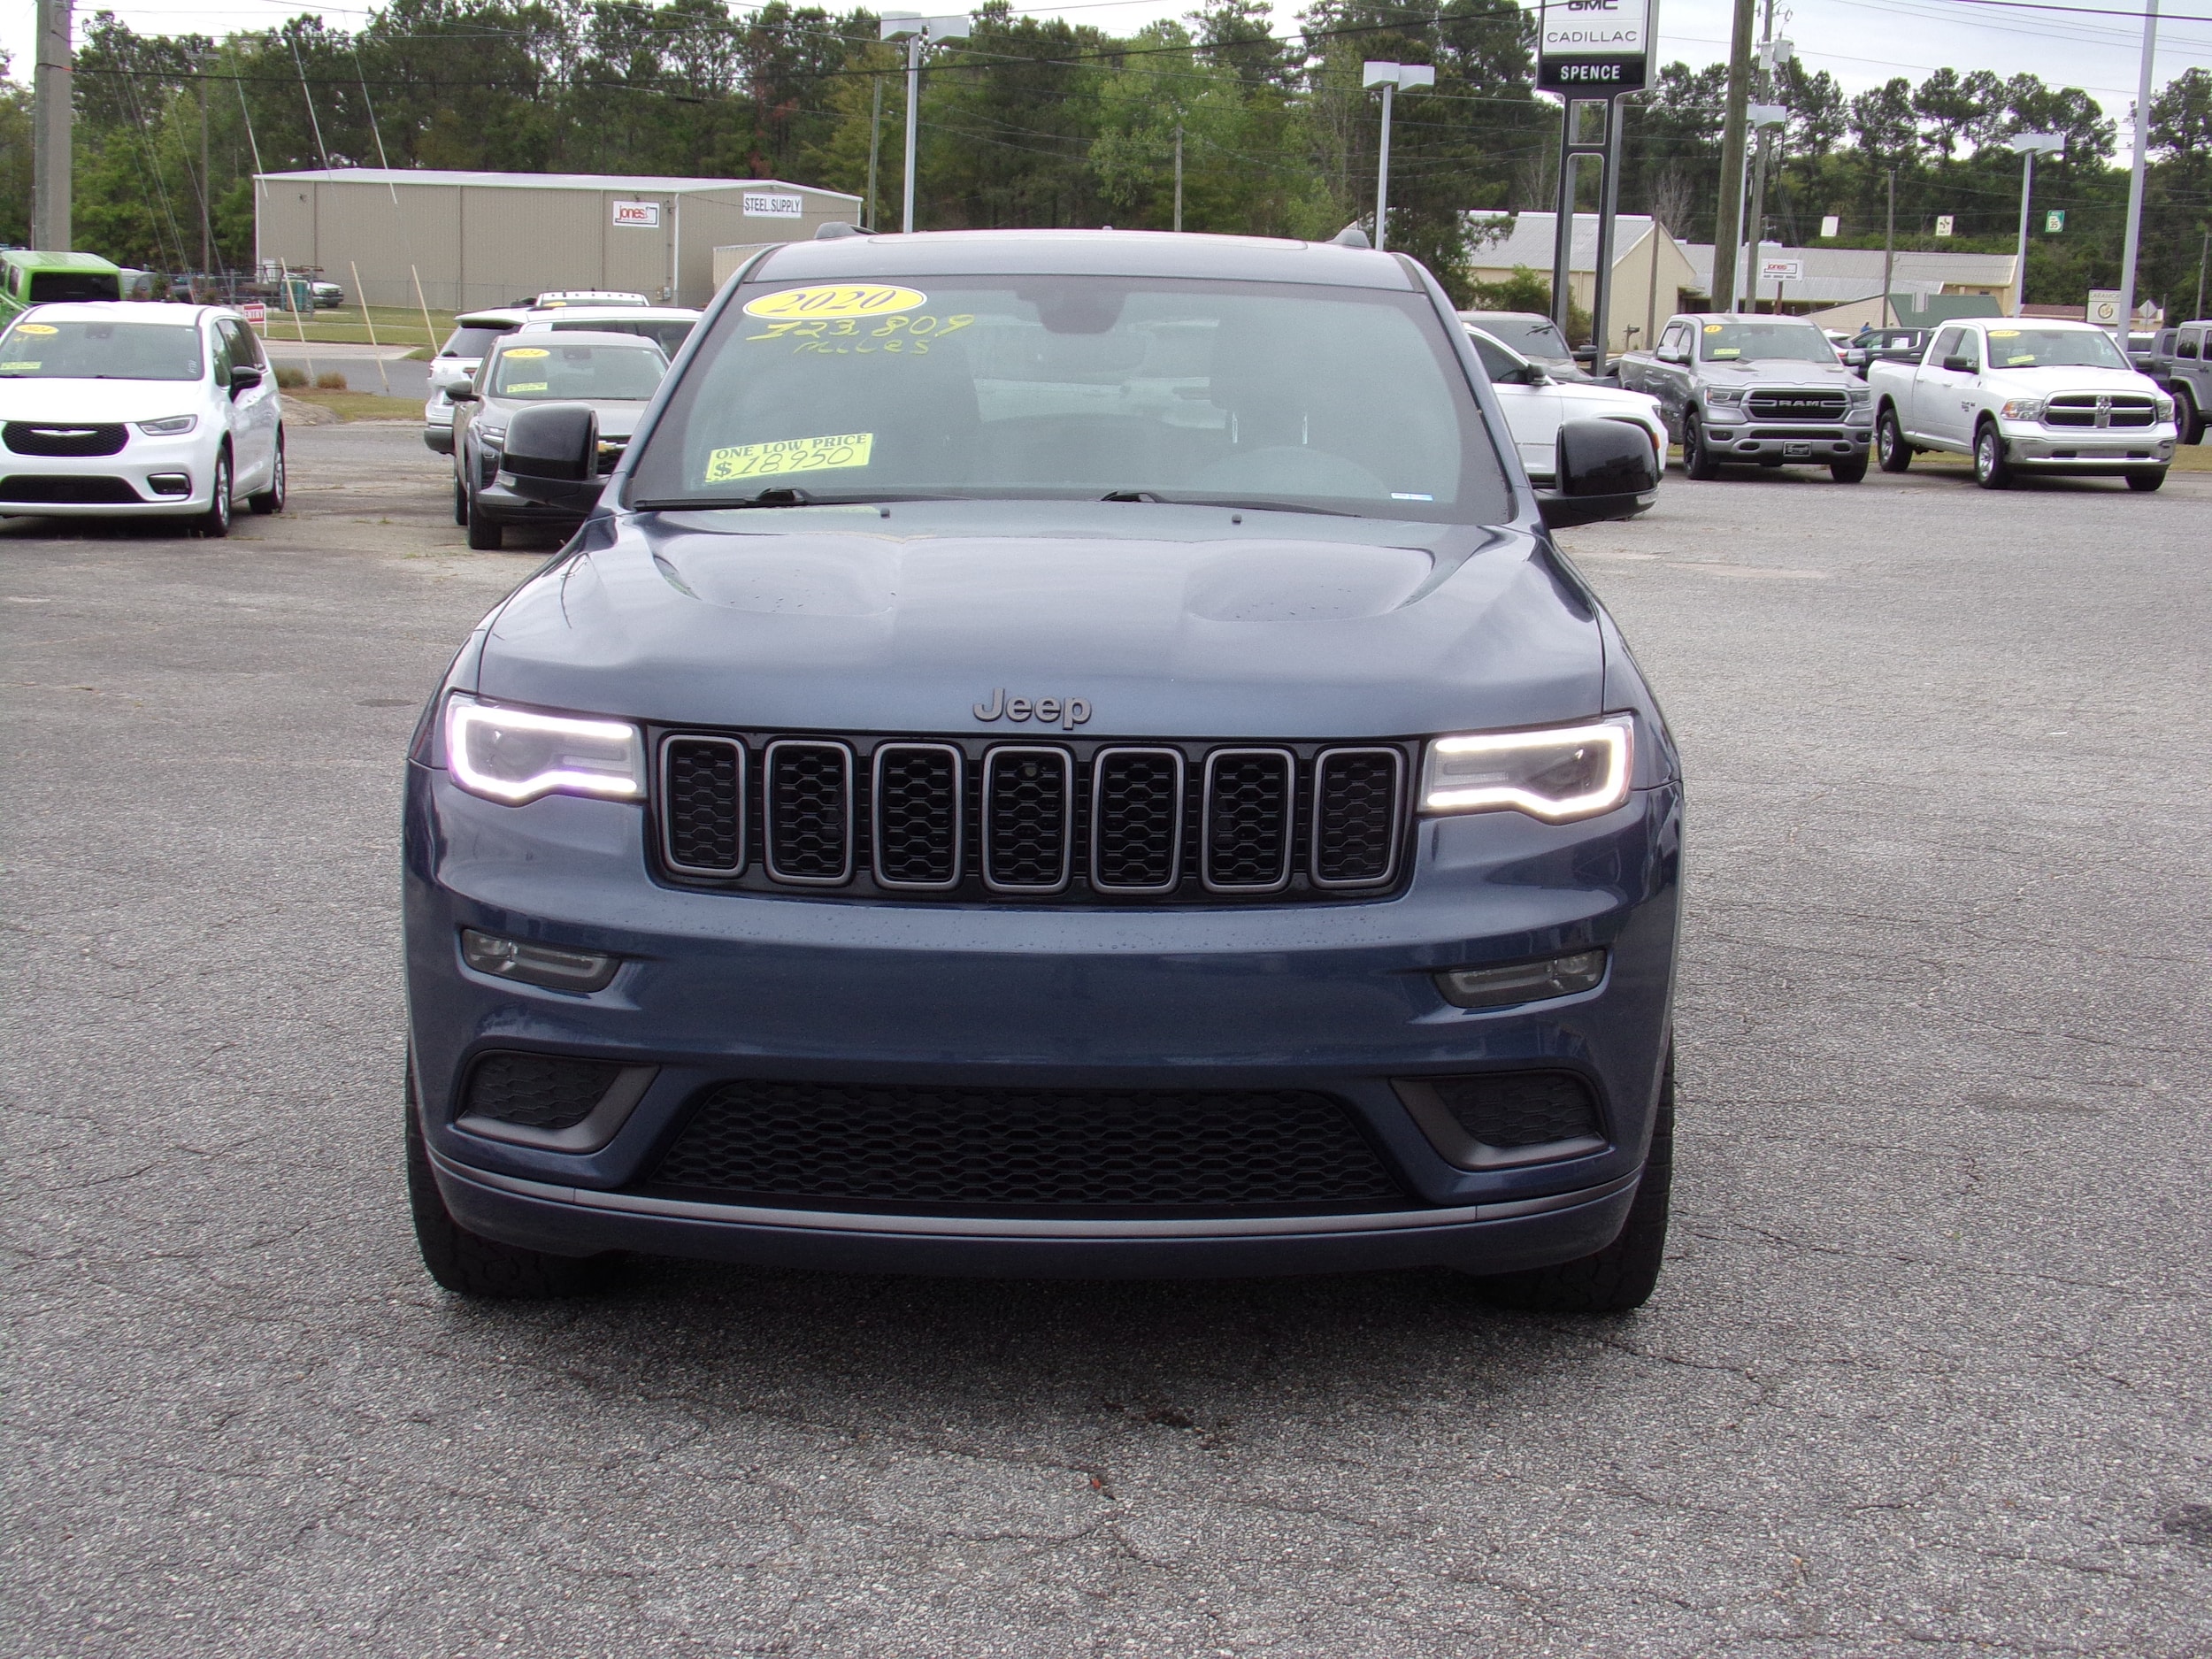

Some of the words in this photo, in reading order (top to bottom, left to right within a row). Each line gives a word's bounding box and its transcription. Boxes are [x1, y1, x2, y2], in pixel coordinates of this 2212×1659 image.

[1547, 30, 1637, 42] CADILLAC
[1560, 65, 1621, 80] SPENCE
[619, 204, 646, 220] jones
[744, 196, 769, 212] STEEL
[771, 197, 801, 213] SUPPLY
[766, 289, 897, 312] 2020
[715, 446, 754, 460] ONE
[762, 440, 803, 455] LOW
[811, 434, 867, 449] PRICE
[972, 687, 1093, 731] Jeep
